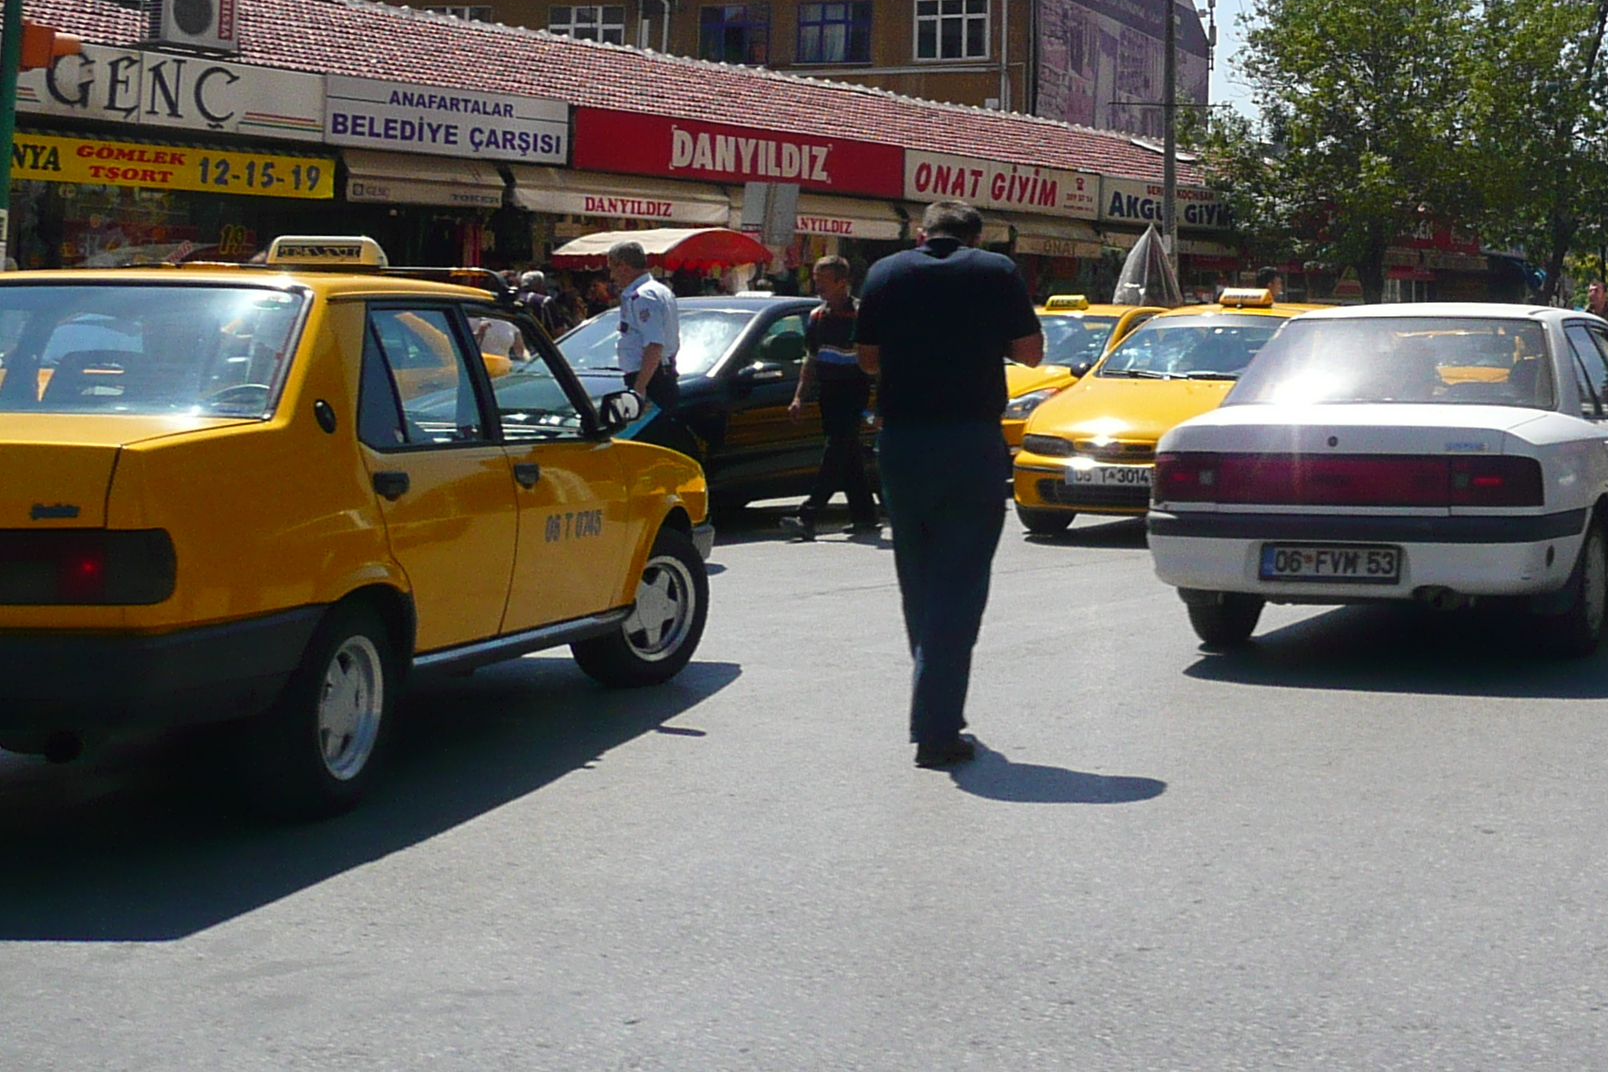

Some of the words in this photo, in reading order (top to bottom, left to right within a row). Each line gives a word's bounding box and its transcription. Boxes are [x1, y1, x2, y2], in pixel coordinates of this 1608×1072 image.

[46, 50, 240, 129] GENÇ
[389, 90, 514, 118] ANAFARTALAR
[332, 113, 458, 144] BELEDİYE
[469, 127, 561, 156] ÇARŞISI
[77, 144, 186, 166] GÖMLEK
[672, 128, 828, 181] DANYILDIZ
[88, 165, 173, 184] TŞORT
[199, 156, 320, 192] 12-15-19
[915, 162, 983, 198] ONAT
[990, 165, 1058, 208] GİYİM
[584, 197, 672, 216] DANYILDIZ
[1117, 469, 1149, 484] 3014
[1275, 550, 1302, 573] 06
[1315, 550, 1359, 574] FVM
[1367, 551, 1394, 575] 53
